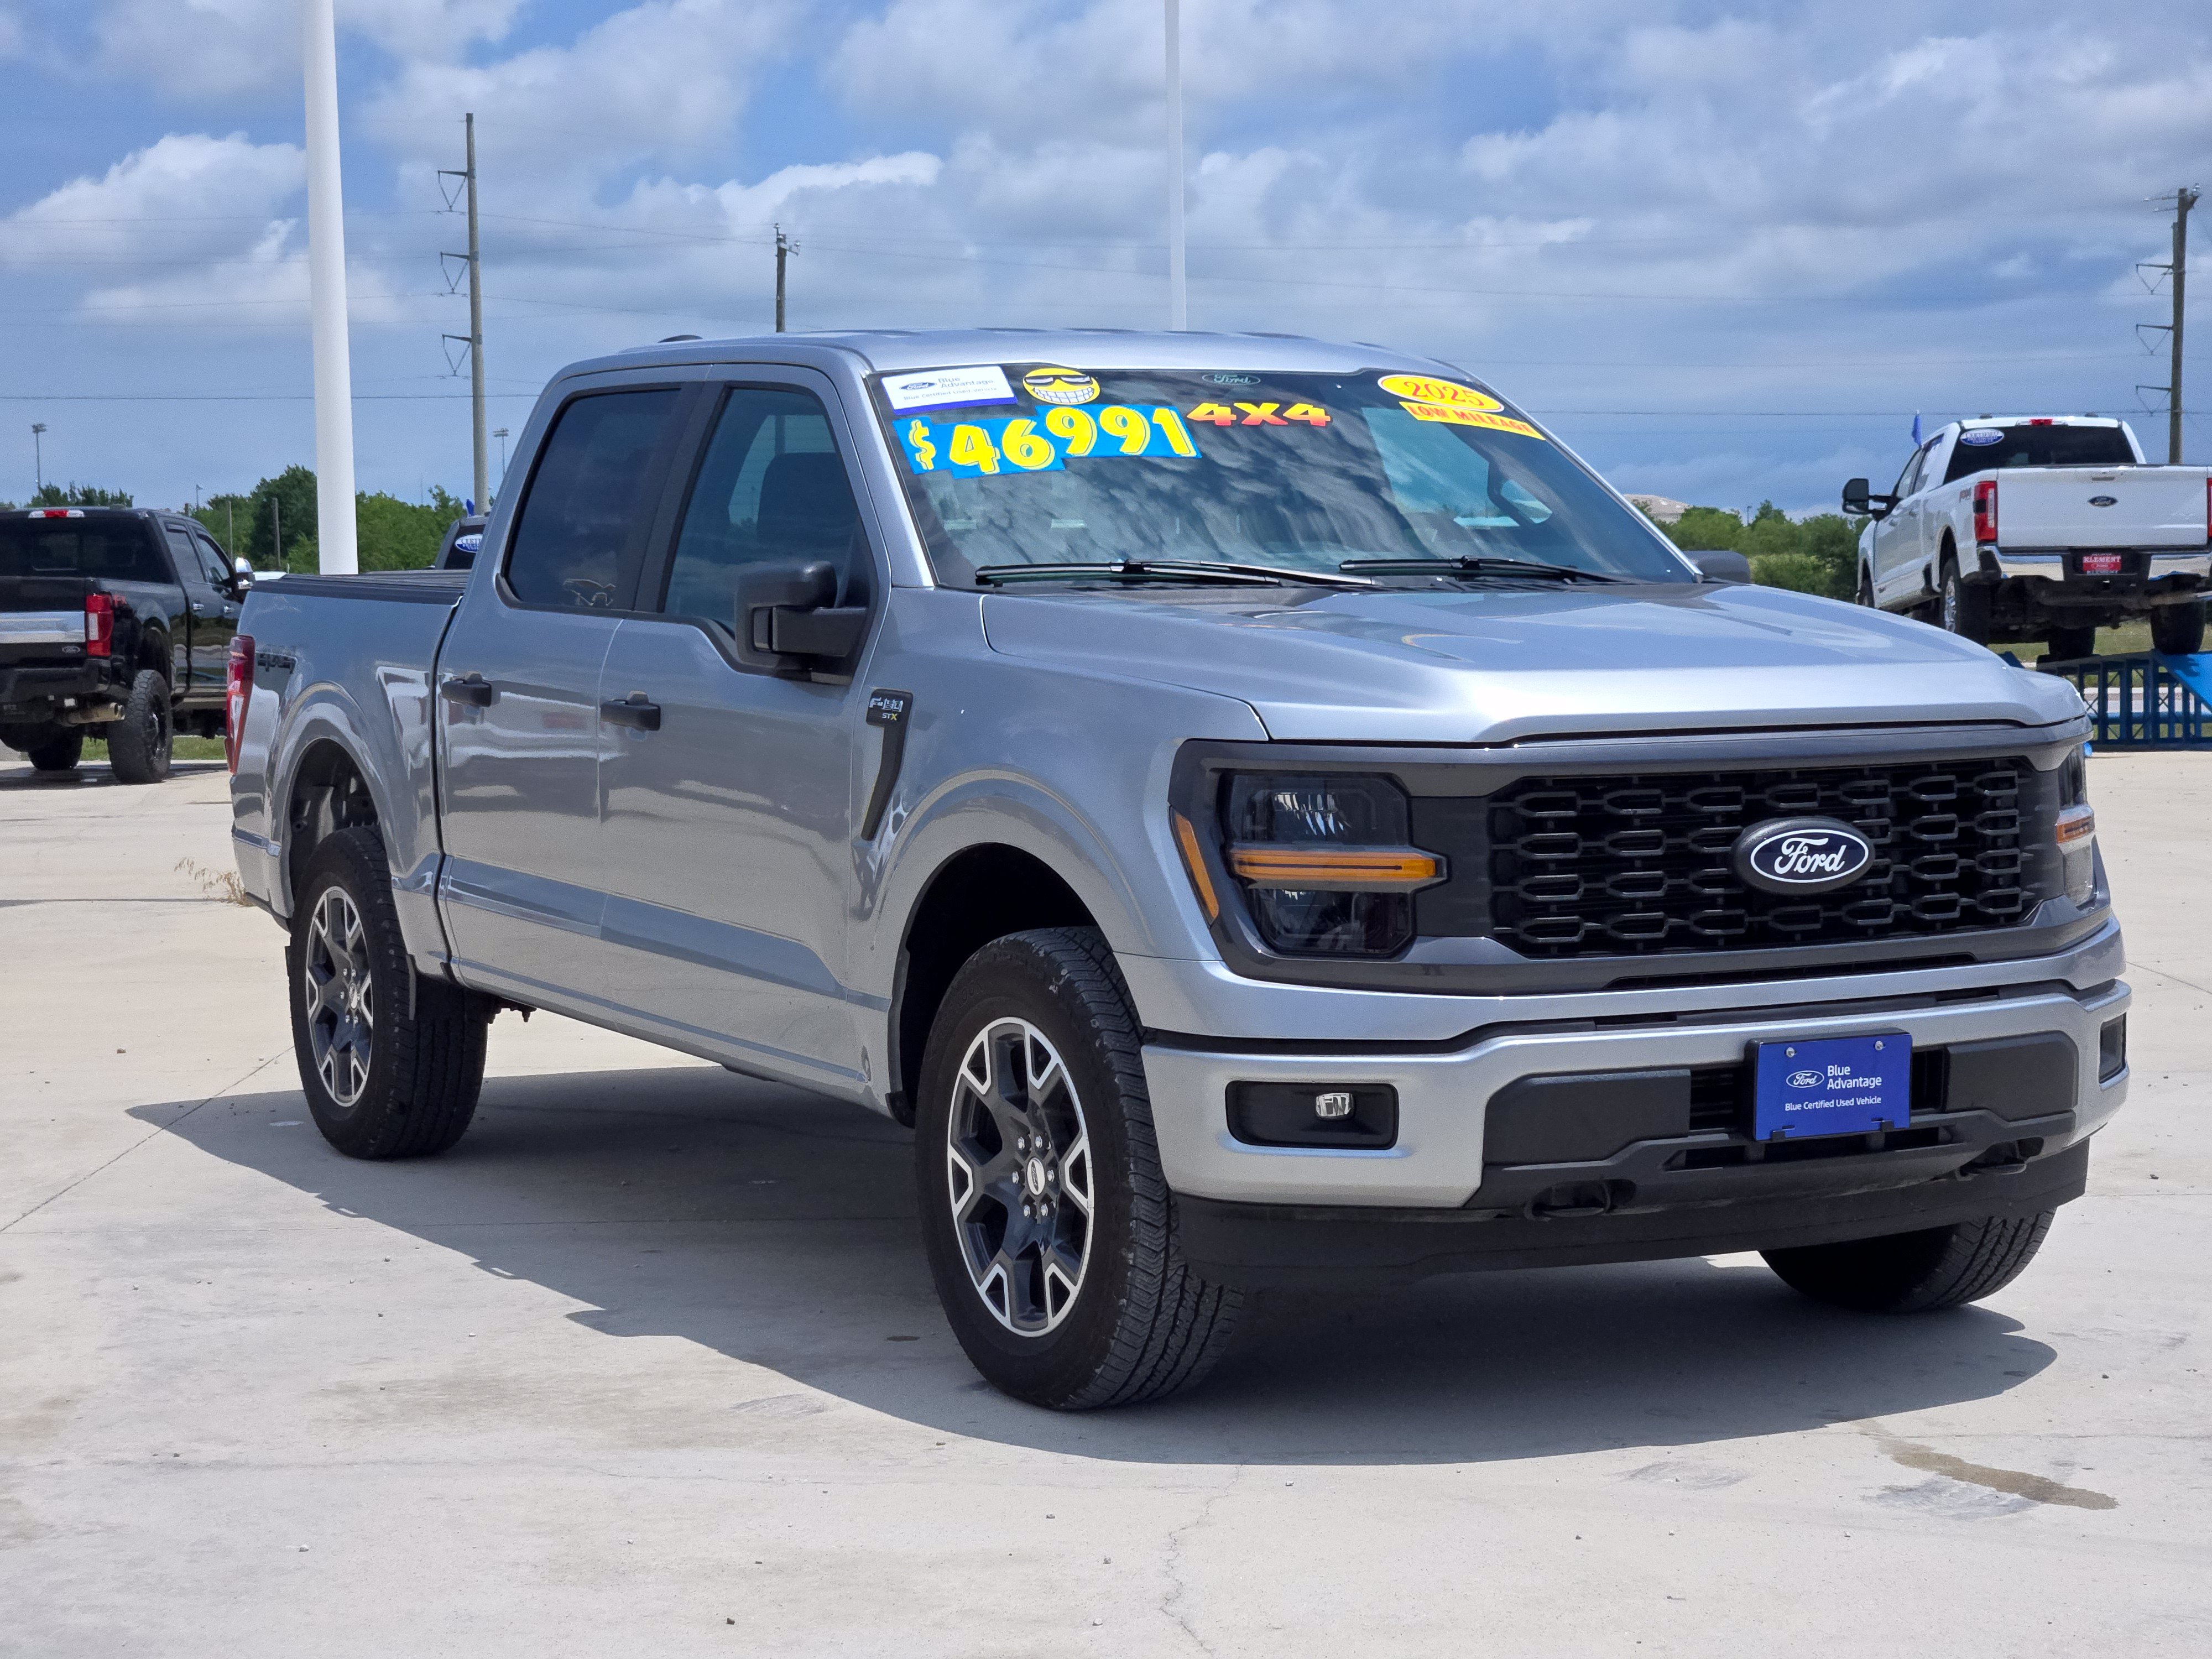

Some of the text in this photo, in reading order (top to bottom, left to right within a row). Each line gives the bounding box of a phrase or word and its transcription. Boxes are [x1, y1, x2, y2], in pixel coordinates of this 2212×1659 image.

[941, 379, 994, 389] Advantage
[1213, 374, 1251, 383] Ford
[1404, 382, 1484, 406] 2025
[1187, 402, 1332, 427] 4X4
[1407, 405, 1537, 435] LOW MILEAGE
[881, 712, 898, 721] STX
[1773, 837, 1847, 874] Ford
[1827, 1065, 1851, 1077] Blue
[1793, 1073, 1818, 1086] Ford
[1827, 1077, 1882, 1090] Advantage
[1785, 1095, 1881, 1111] Blue Certified Used Vehicle
